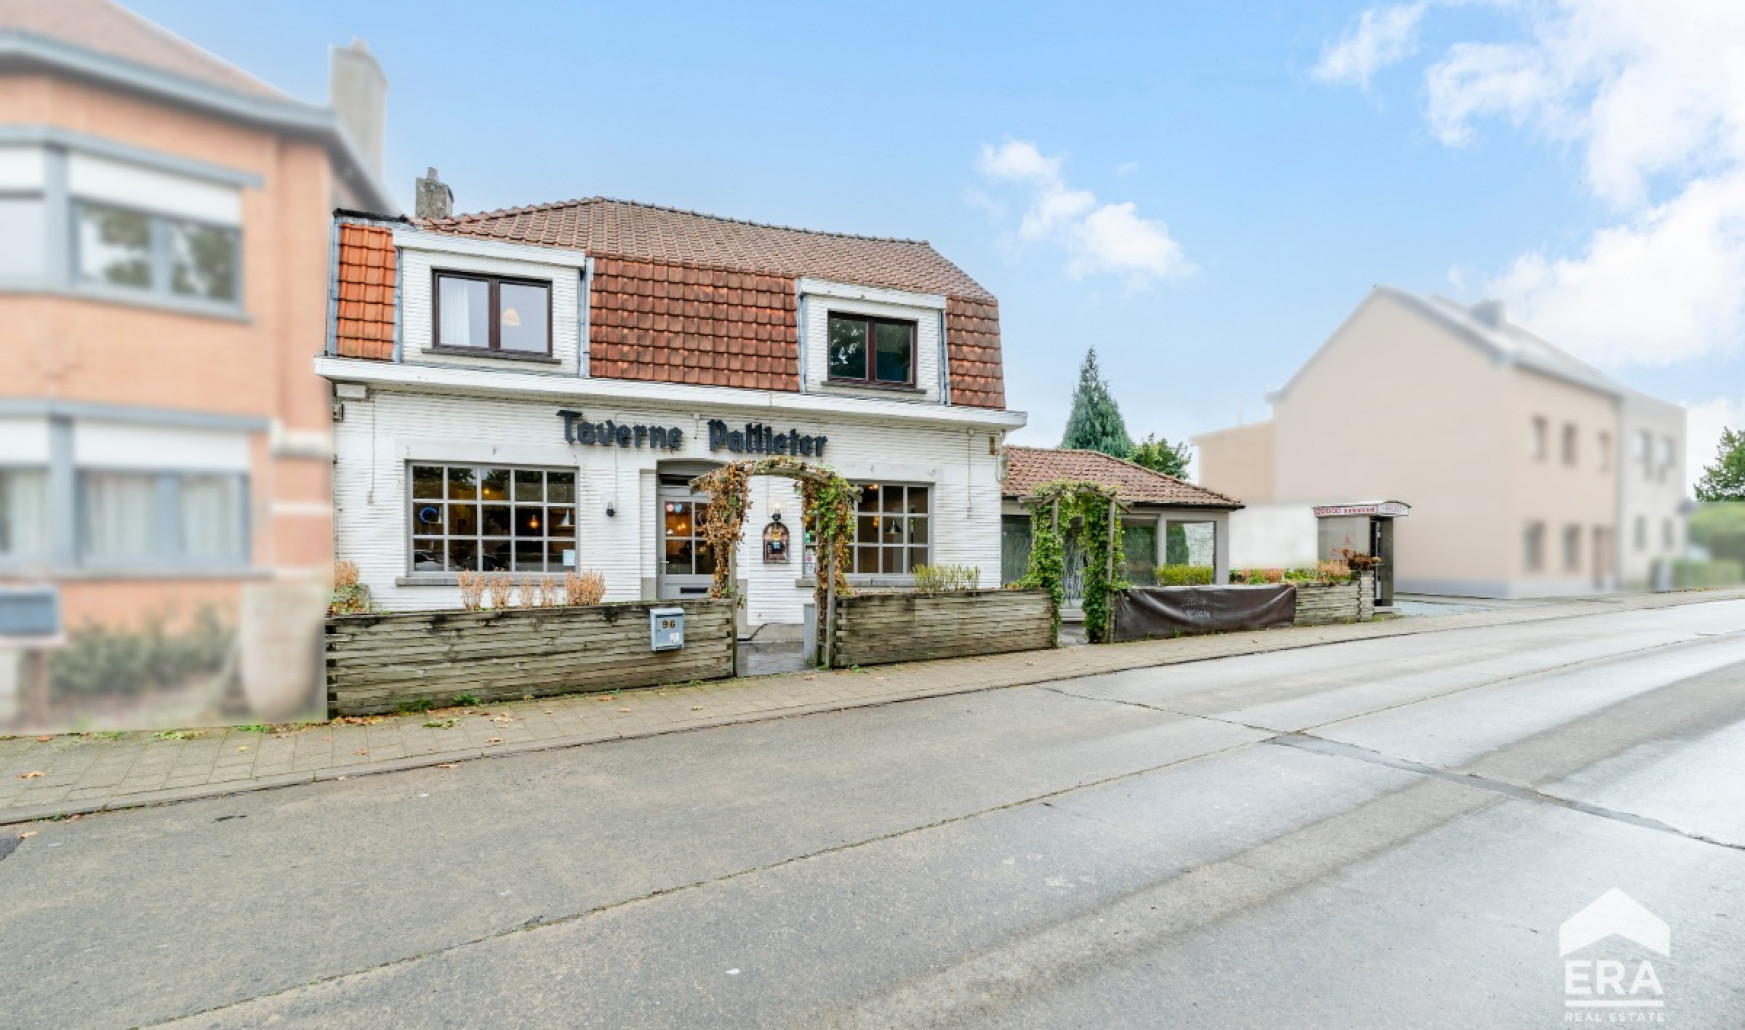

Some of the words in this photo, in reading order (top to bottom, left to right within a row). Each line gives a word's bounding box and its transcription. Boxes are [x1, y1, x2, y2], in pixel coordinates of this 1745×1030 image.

[556, 409, 683, 450] Taverne
[707, 418, 828, 457] Pallieter
[662, 619, 676, 629] 96
